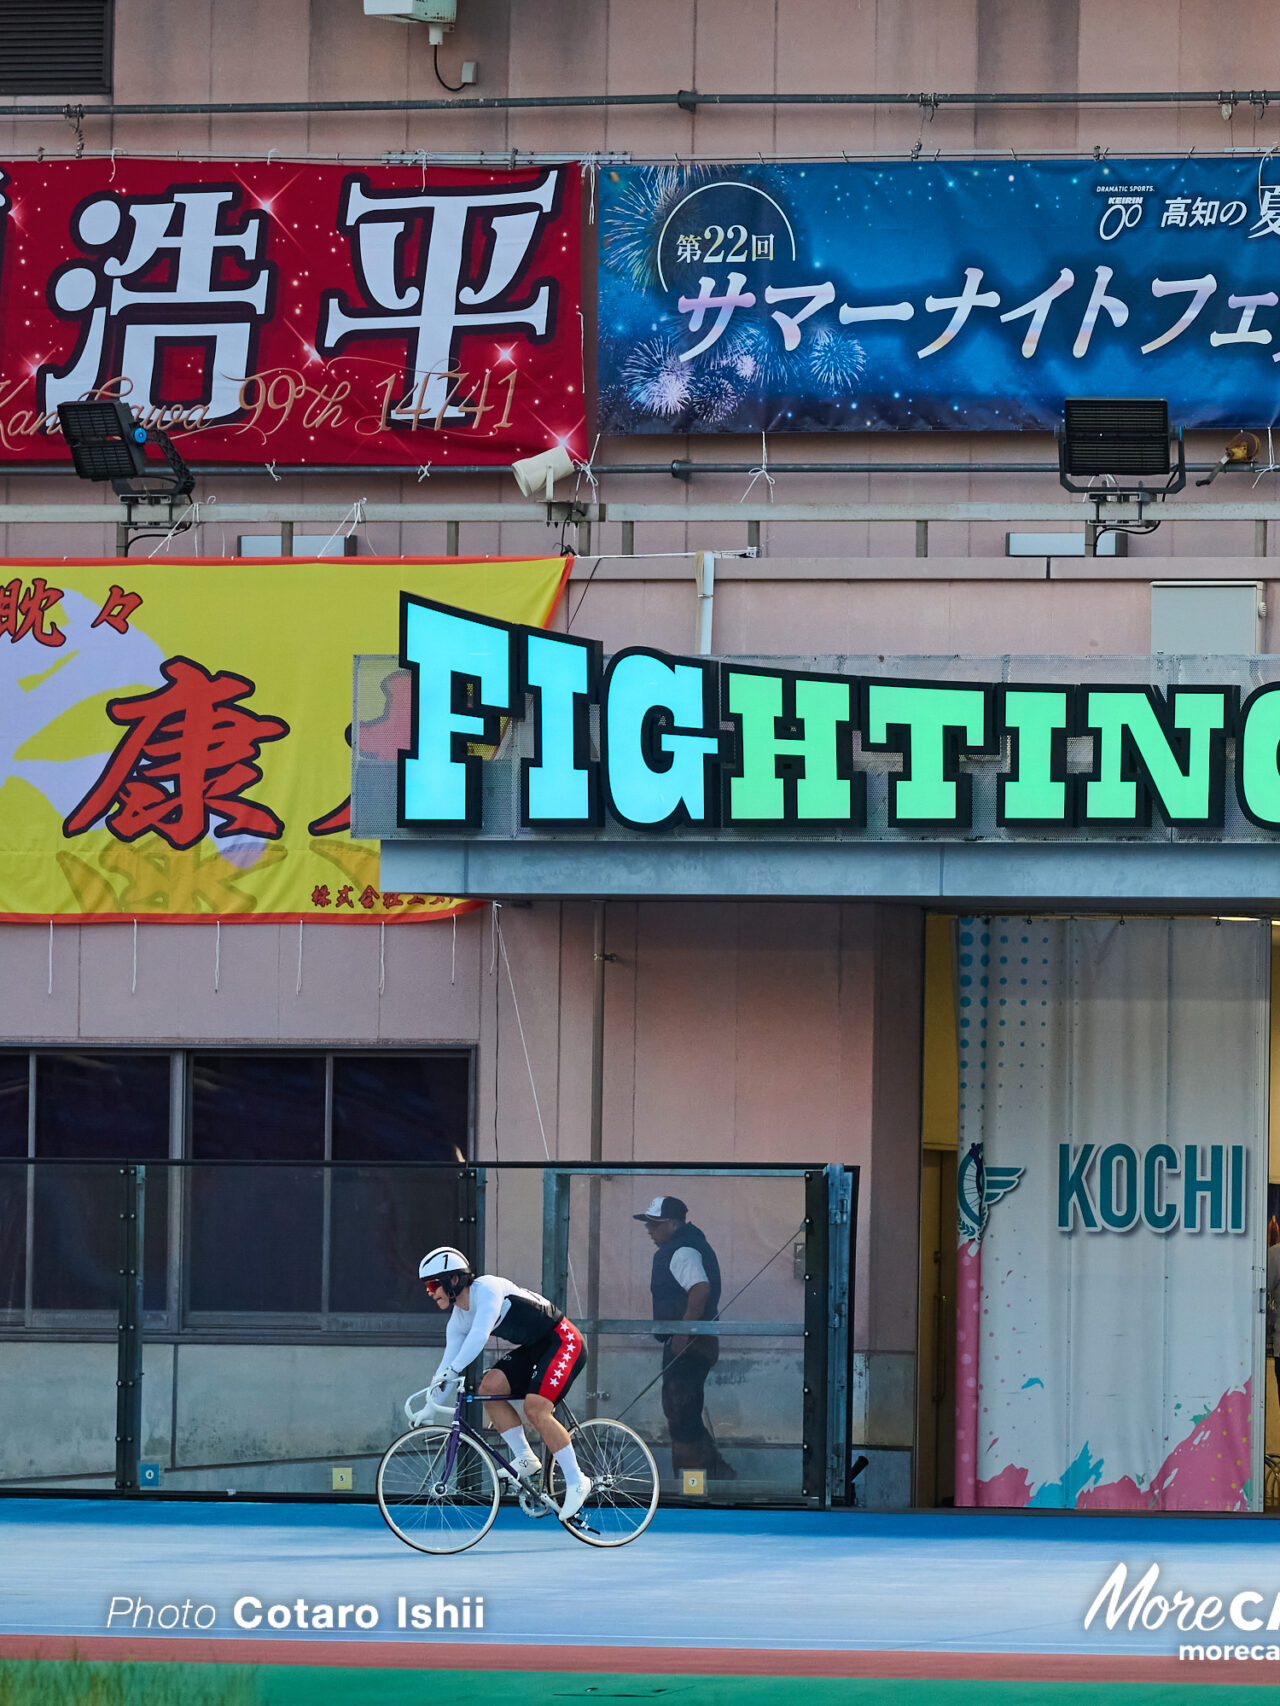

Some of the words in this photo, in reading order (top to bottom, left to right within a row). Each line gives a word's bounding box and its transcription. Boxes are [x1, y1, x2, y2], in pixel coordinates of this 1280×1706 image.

[676, 224, 775, 264] 第22回
[45, 169, 558, 424] 浩平
[350, 361, 517, 437] 14741
[1057, 1143, 1245, 1230] KOCHI
[443, 1254, 448, 1270] 1
